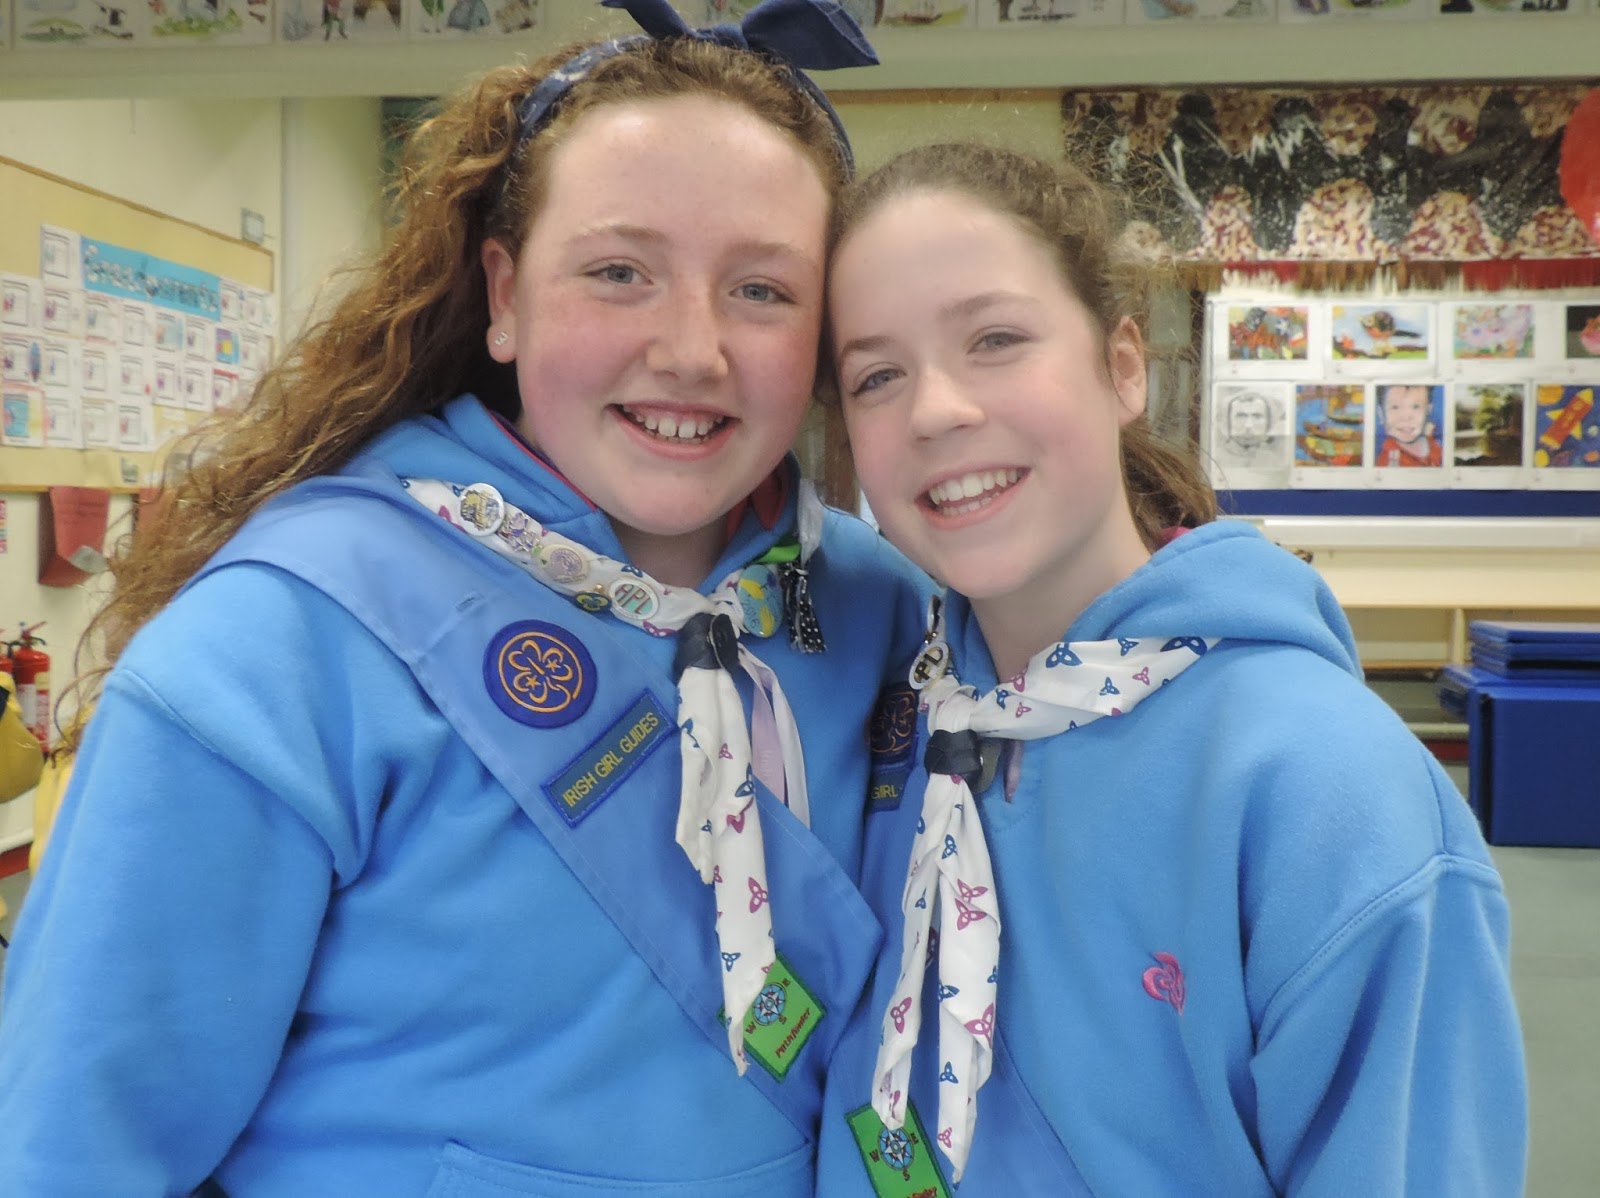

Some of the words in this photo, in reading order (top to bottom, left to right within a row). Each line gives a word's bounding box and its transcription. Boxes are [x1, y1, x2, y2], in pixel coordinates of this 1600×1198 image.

[562, 772, 598, 808] IRISH
[594, 750, 623, 778] GIRL
[619, 712, 659, 753] GUIDES
[871, 784, 898, 799] GIRL
[869, 1149, 880, 1162] W
[902, 1168, 911, 1181] S
